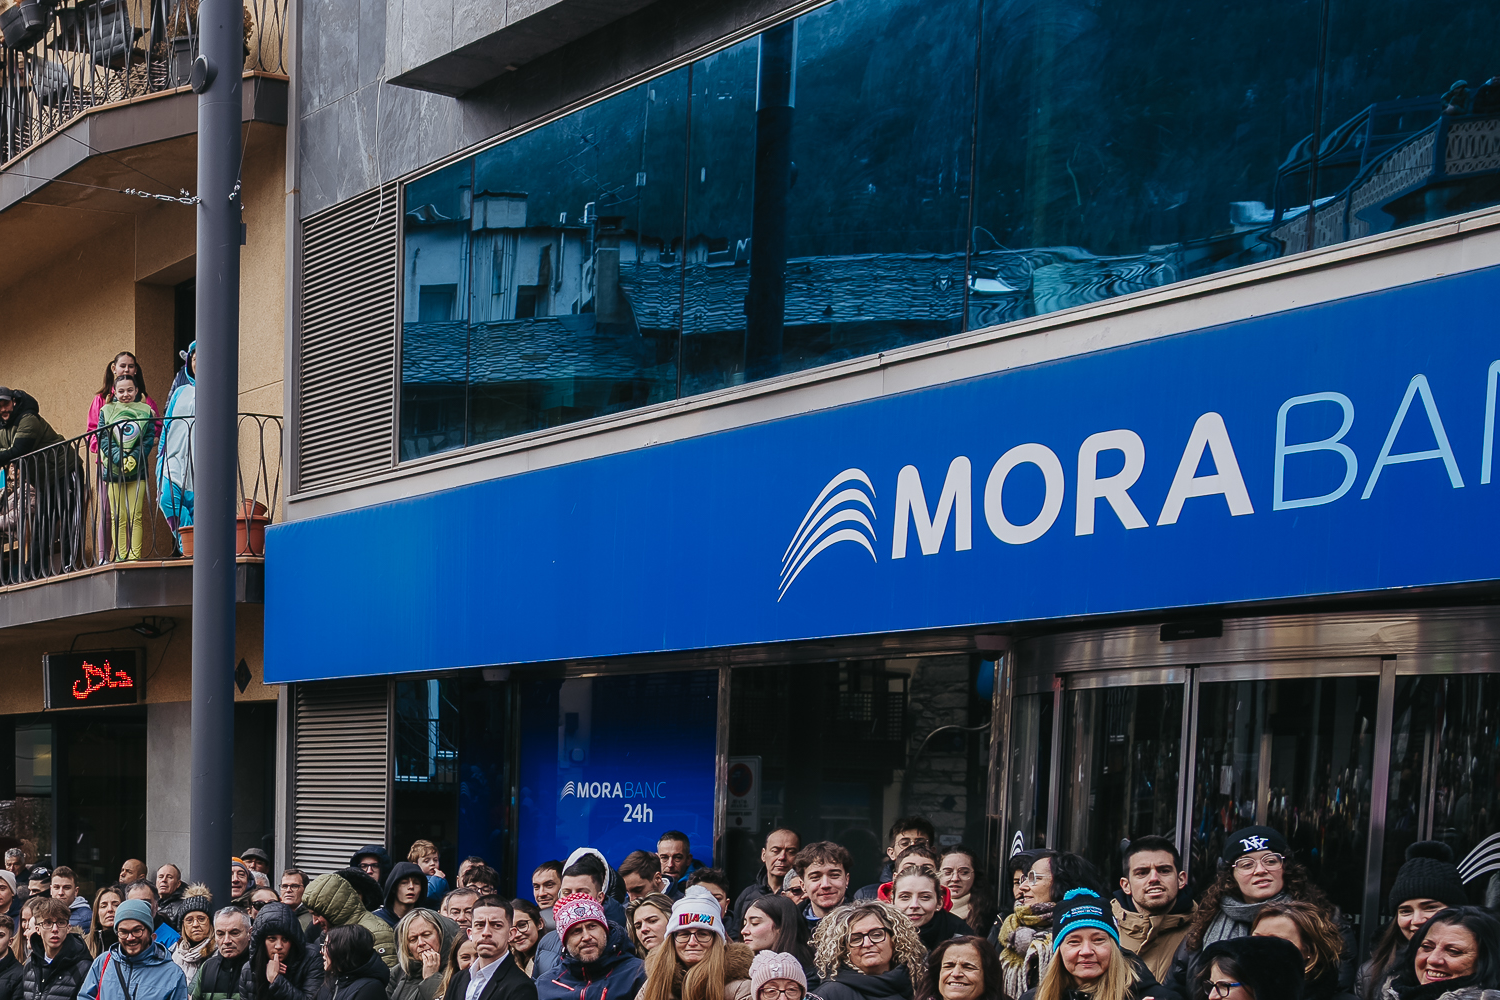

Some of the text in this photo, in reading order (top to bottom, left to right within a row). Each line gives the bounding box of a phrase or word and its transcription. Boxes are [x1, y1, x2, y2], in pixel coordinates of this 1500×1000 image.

[891, 357, 1500, 560] MORABA
[623, 803, 653, 823] 24h
[1239, 835, 1269, 852] NY
[679, 912, 715, 927] MIAMI
